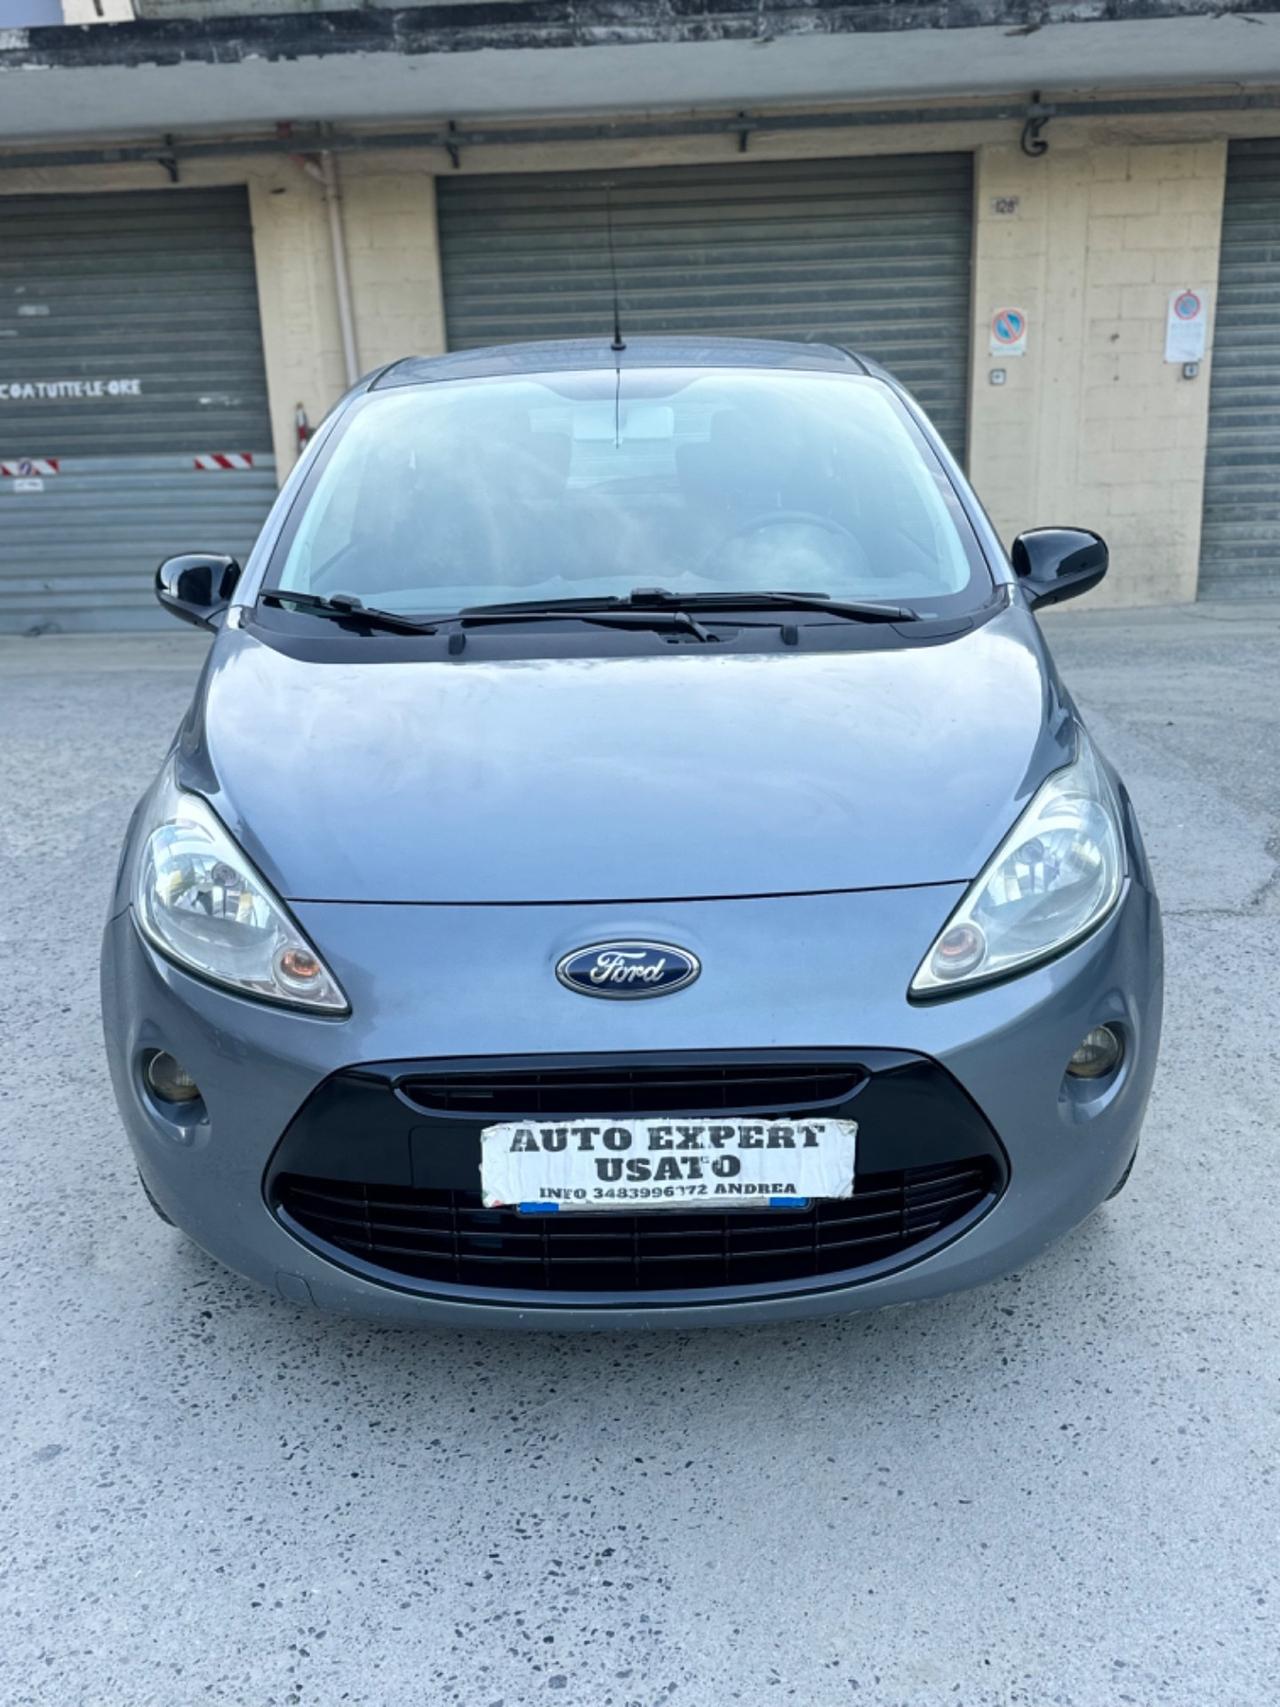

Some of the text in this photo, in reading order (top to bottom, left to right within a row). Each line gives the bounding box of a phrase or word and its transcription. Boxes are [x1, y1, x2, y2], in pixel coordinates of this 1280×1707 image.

[590, 951, 666, 984] Ford
[509, 1125, 826, 1152] AUTO EXPERT
[594, 1154, 741, 1182] USATO
[539, 1187, 587, 1200] INFO
[714, 1183, 797, 1195] ANDREA
